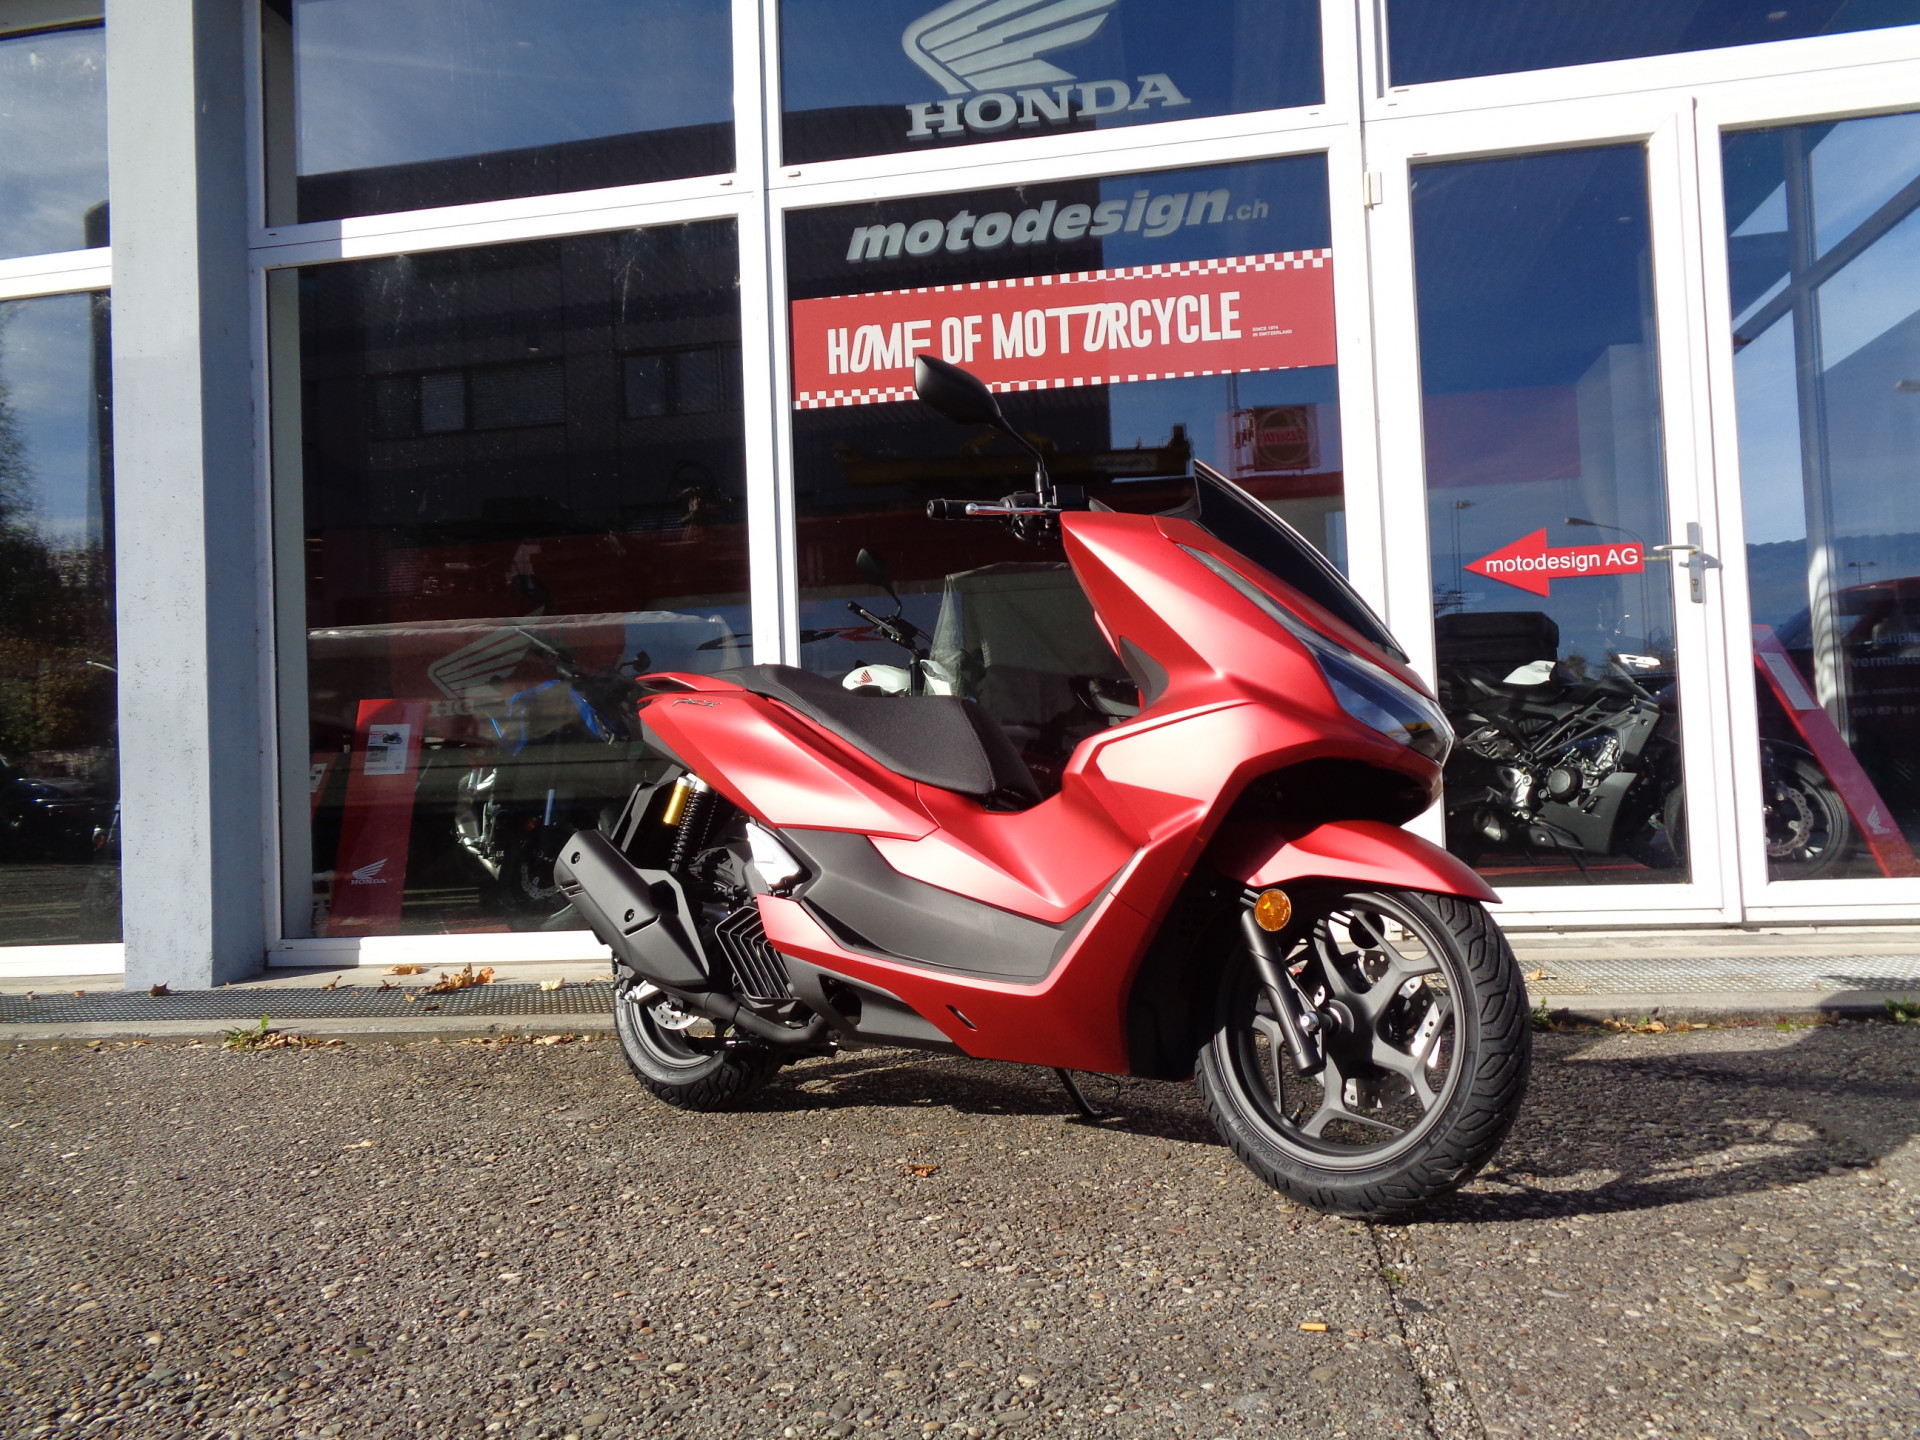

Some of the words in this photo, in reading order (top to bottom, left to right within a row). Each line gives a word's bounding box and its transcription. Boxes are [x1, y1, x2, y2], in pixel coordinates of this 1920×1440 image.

[905, 73, 1191, 141] HONDA
[846, 188, 1269, 262] motodesign.ch
[827, 319, 932, 375] HOME
[941, 314, 983, 365] OF
[992, 291, 1242, 360] MOTORCYCLE
[1258, 329, 1293, 337] SWITZERLAND
[1485, 552, 1601, 573] motodesign
[1605, 547, 1639, 567] AG
